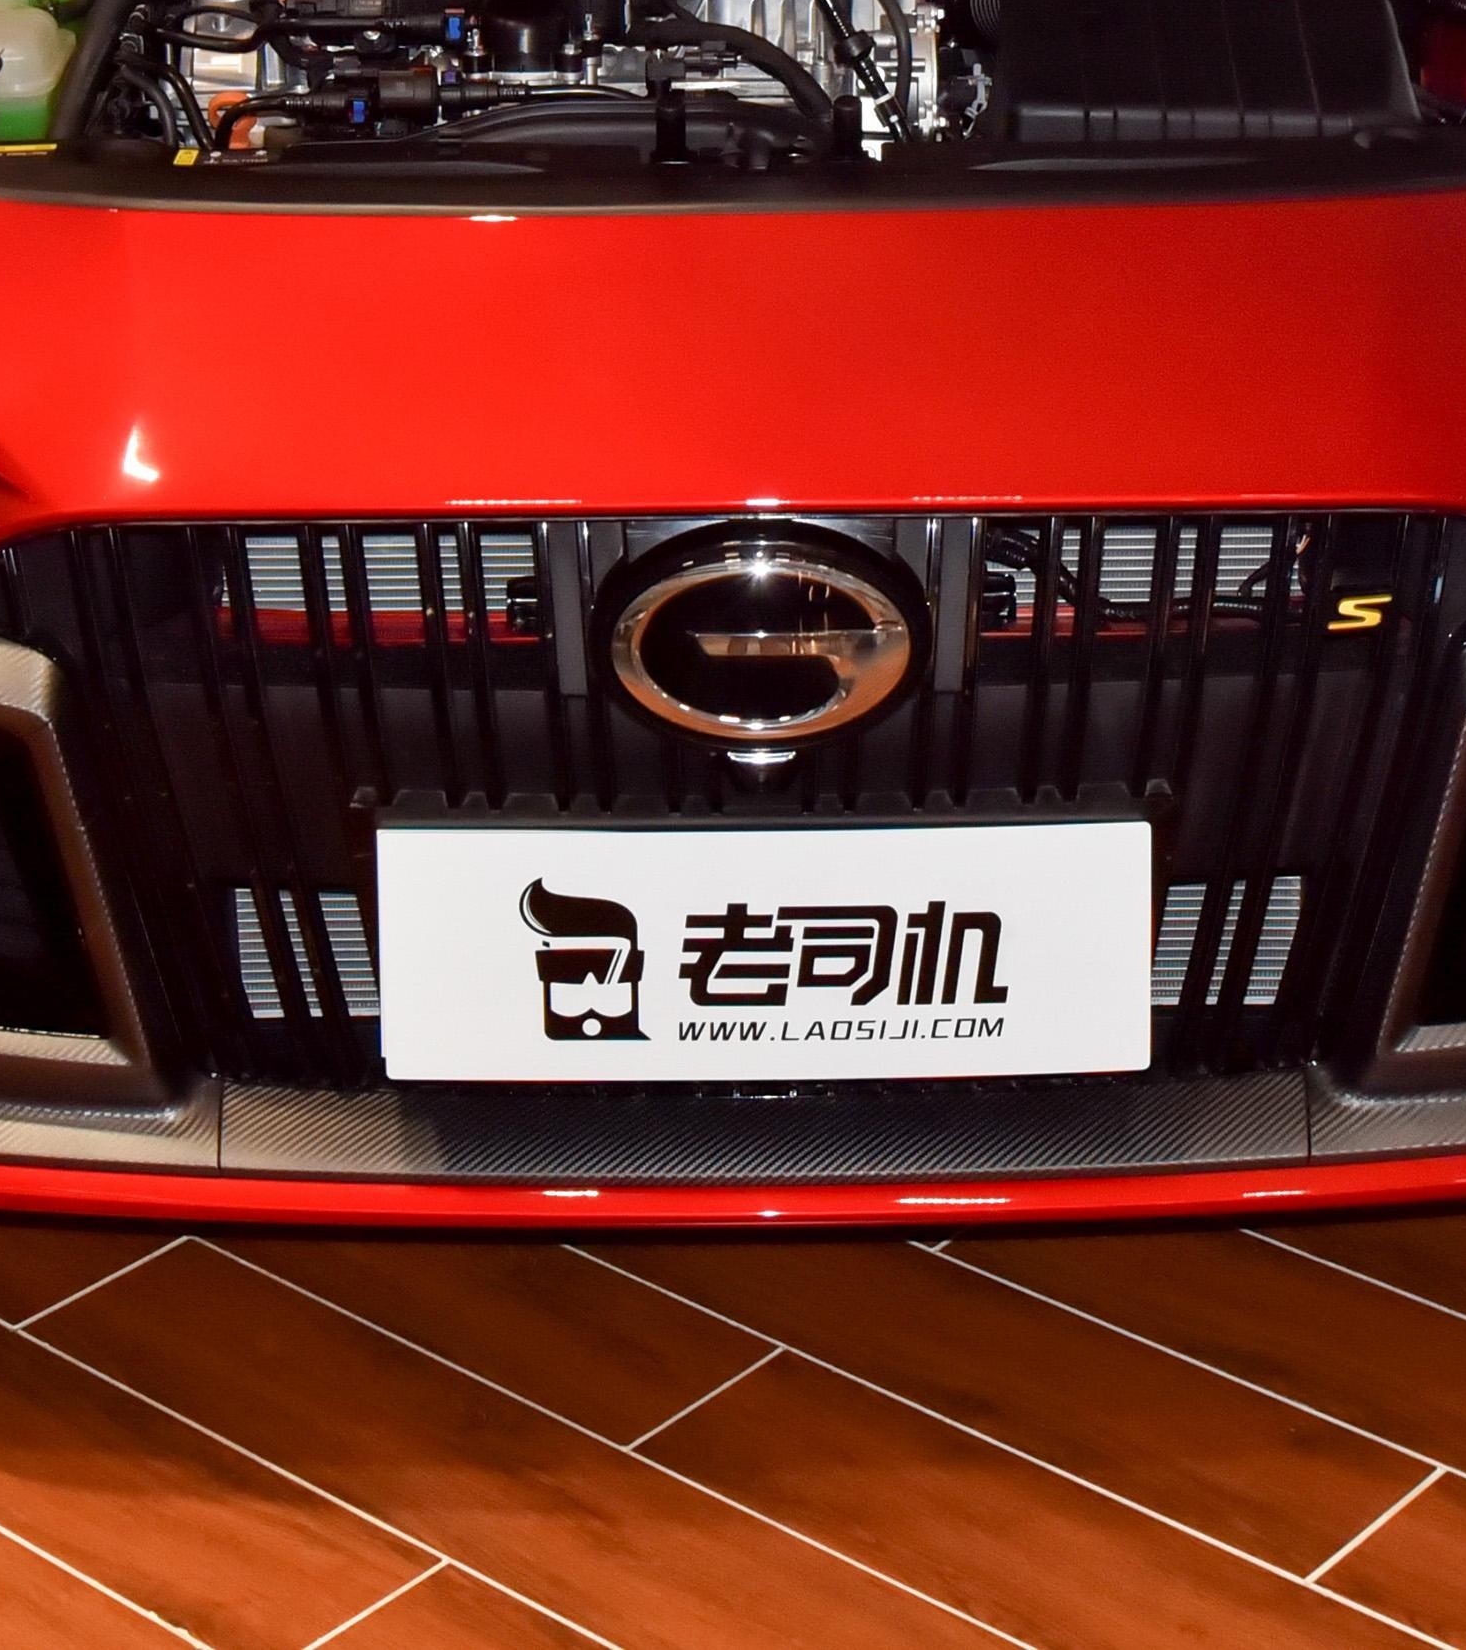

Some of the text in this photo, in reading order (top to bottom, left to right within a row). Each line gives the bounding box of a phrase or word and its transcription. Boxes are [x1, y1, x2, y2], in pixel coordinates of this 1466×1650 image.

[678, 901, 1009, 1007] 老司机
[678, 1017, 1005, 1043] WWW.LAOSIJI.COM
